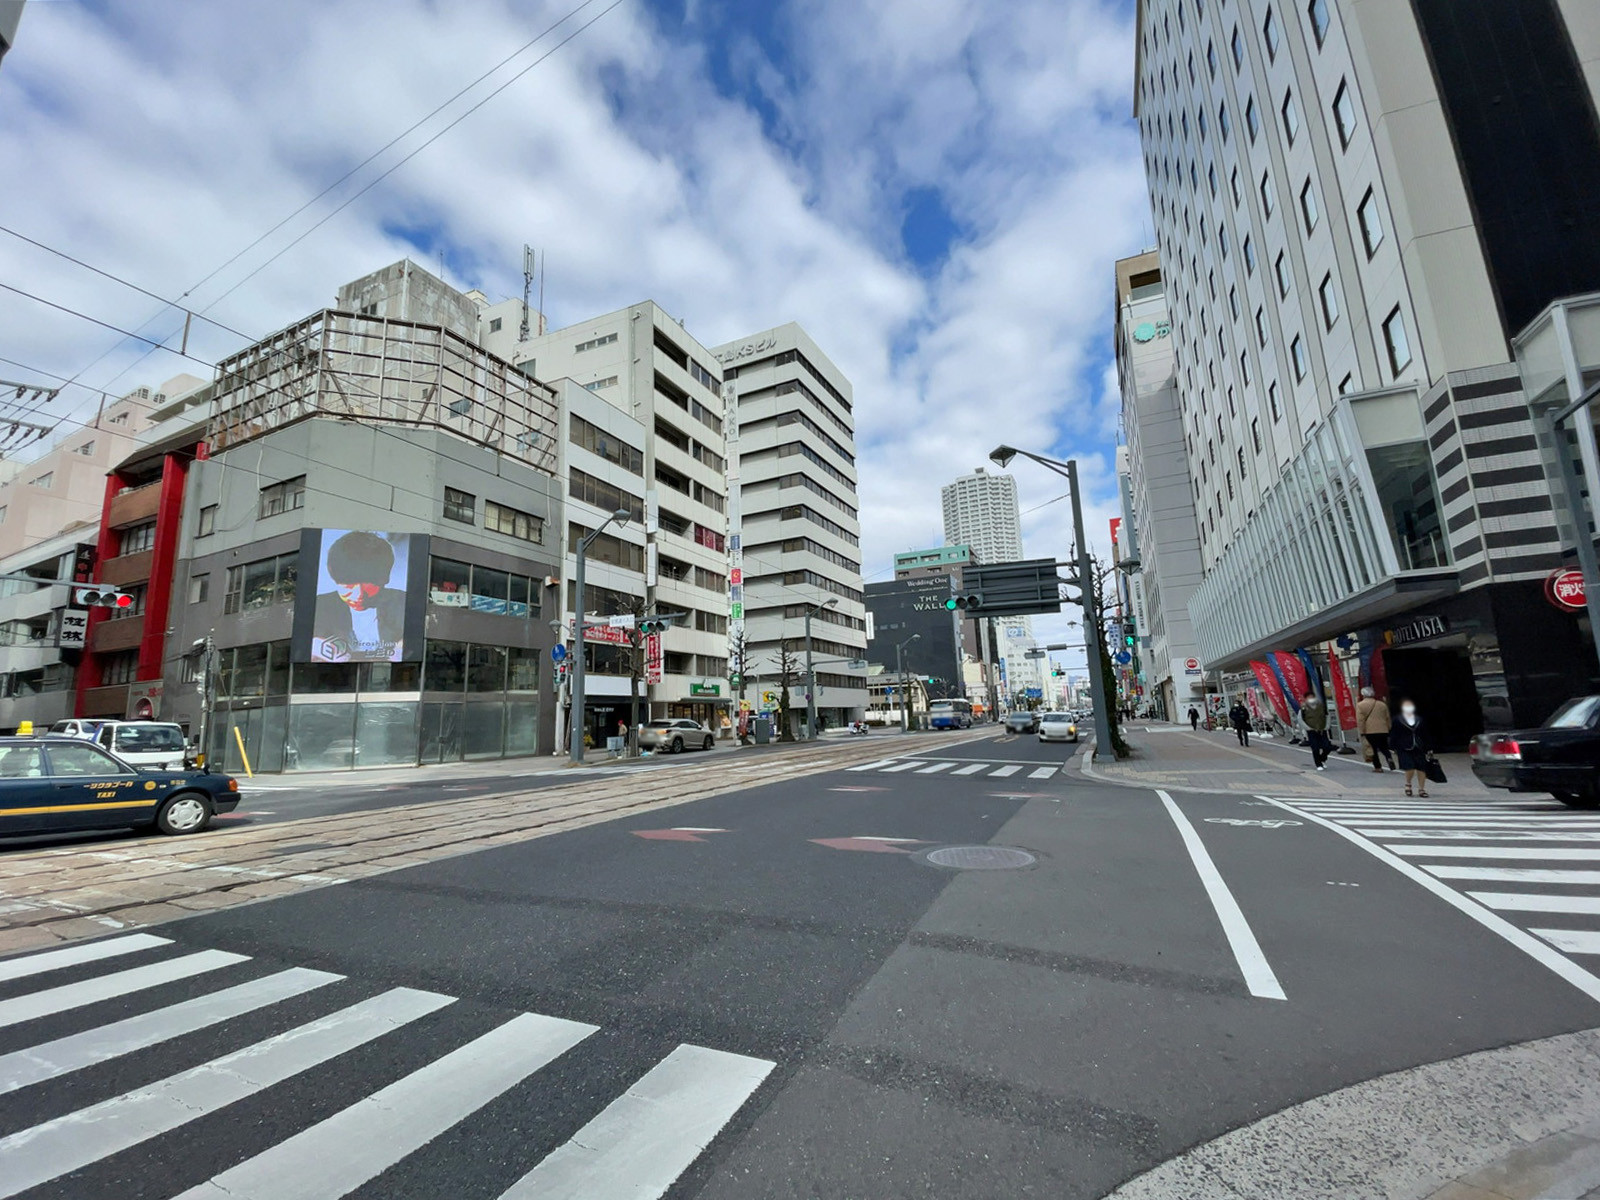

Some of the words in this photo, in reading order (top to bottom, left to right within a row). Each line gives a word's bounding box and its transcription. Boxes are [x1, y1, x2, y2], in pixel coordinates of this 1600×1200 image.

[727, 398, 736, 435] WAKO
[906, 578, 934, 587] Wedding
[1557, 582, 1586, 598] 消火
[918, 595, 938, 603] THE
[913, 602, 945, 612] WALL
[1412, 616, 1444, 639] VISTA
[96, 791, 116, 799] TAXI
